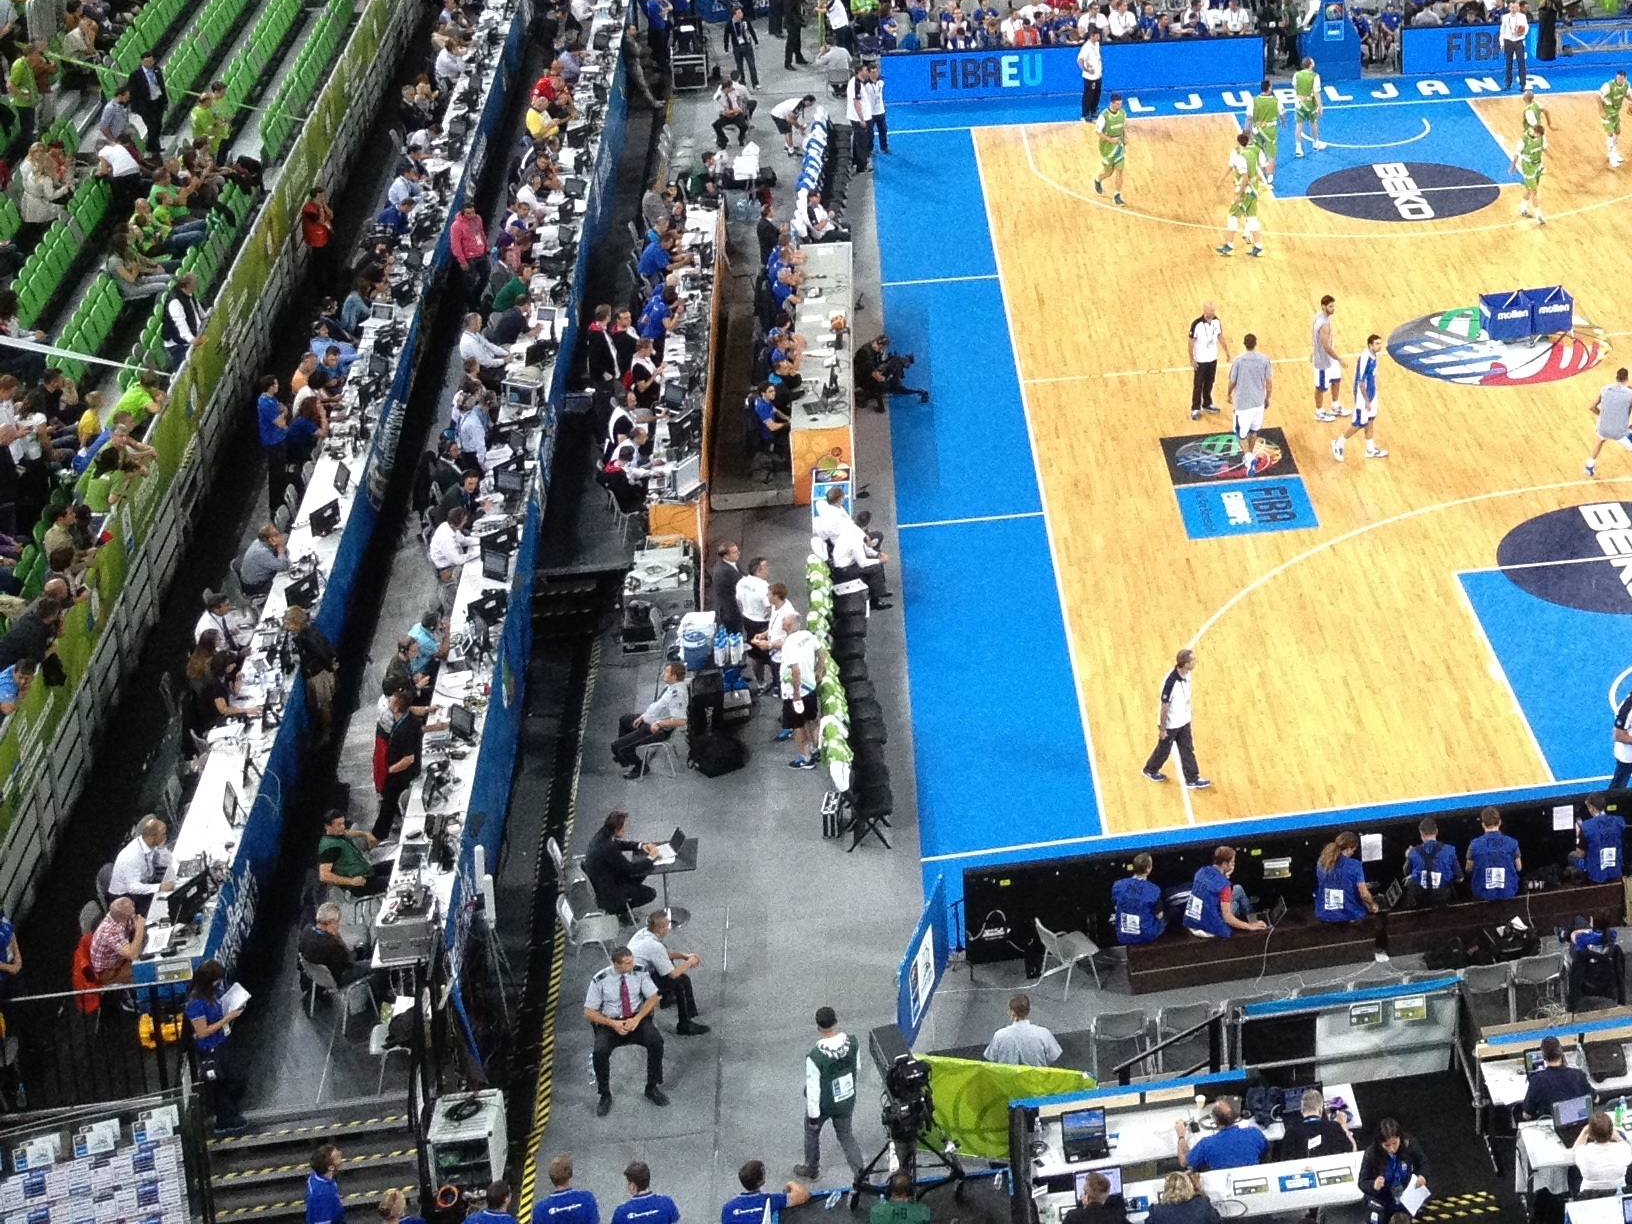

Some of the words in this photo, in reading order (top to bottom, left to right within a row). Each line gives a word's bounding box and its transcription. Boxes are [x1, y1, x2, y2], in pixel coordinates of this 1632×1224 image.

[930, 54, 1043, 91] FIBAEU
[1372, 163, 1435, 219] BEKO
[1498, 310, 1529, 320] molten
[1539, 304, 1570, 314] molten
[1247, 486, 1297, 524] FIBA
[548, 1203, 582, 1215] Champion
